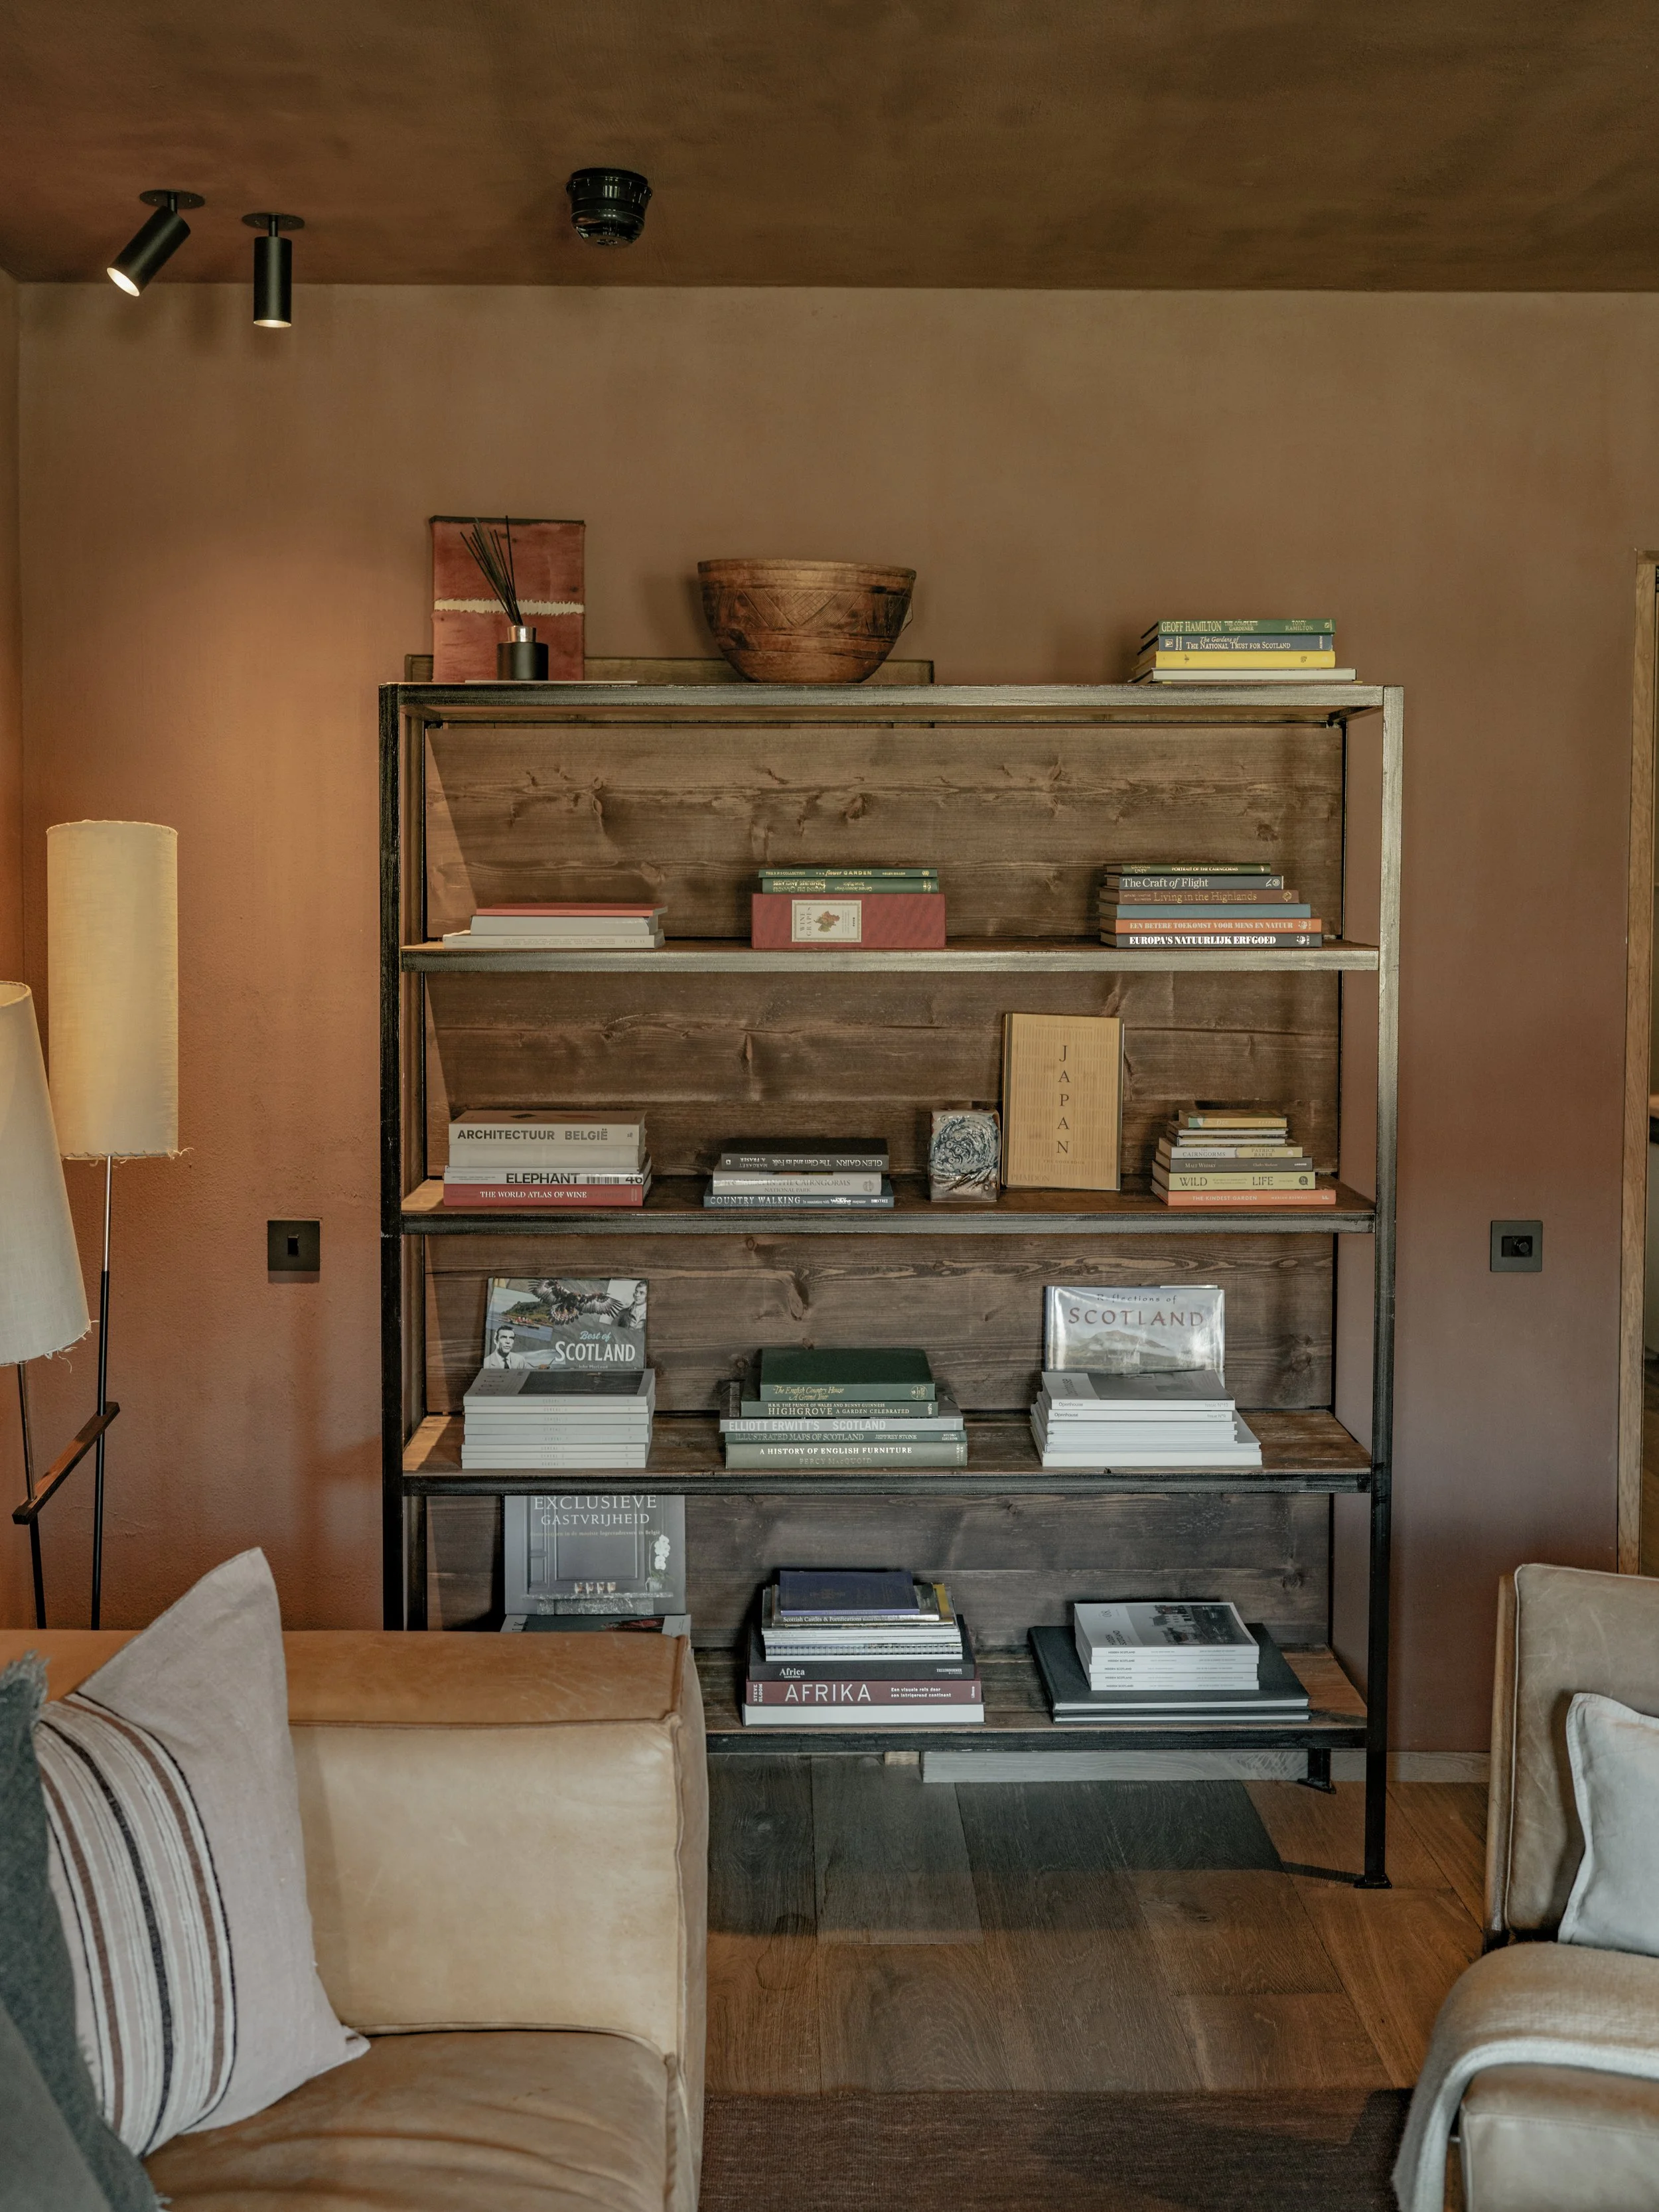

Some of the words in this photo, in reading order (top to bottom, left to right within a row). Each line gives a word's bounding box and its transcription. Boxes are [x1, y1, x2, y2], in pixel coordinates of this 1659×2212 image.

[1161, 621, 1184, 632] GEOFF
[1185, 621, 1222, 632] HAMILTON
[1123, 878, 1141, 887] The
[1142, 877, 1167, 887] Craft
[1169, 877, 1179, 889] of
[1181, 877, 1208, 889] Flight
[1153, 892, 1182, 903] Living
[1211, 891, 1257, 903] Highlands
[1129, 936, 1173, 944] EUROPA'S
[1175, 936, 1232, 944] NATUURLIJK
[1233, 936, 1276, 944] ERFGOED
[1056, 1045, 1071, 1153] JAPAN
[457, 1130, 555, 1140] ARCHITECTUUR
[565, 1128, 608, 1140] BELGIË
[506, 1173, 581, 1184] ELEPHANT
[1179, 1177, 1208, 1187] WILD
[1252, 1176, 1273, 1186] LIFE
[758, 1196, 800, 1205] WALKING
[1096, 1293, 1160, 1303] Rflections
[1166, 1295, 1177, 1304] of
[1068, 1307, 1204, 1326] SCOTLAND
[579, 1330, 601, 1340] Best
[601, 1331, 611, 1342] of
[555, 1341, 636, 1362] SCOTLAND
[773, 1385, 784, 1394] The
[806, 1386, 828, 1394] Country
[729, 1420, 768, 1430] ELLIOTT
[772, 1420, 820, 1430] ERWITT'S
[832, 1420, 886, 1430] SCOTLAND
[534, 1495, 656, 1509] EXCLUSIEVE
[541, 1513, 650, 1527] GASTVRIJHEID
[779, 1667, 805, 1676] Africa
[784, 1684, 871, 1702] AFRIKA
